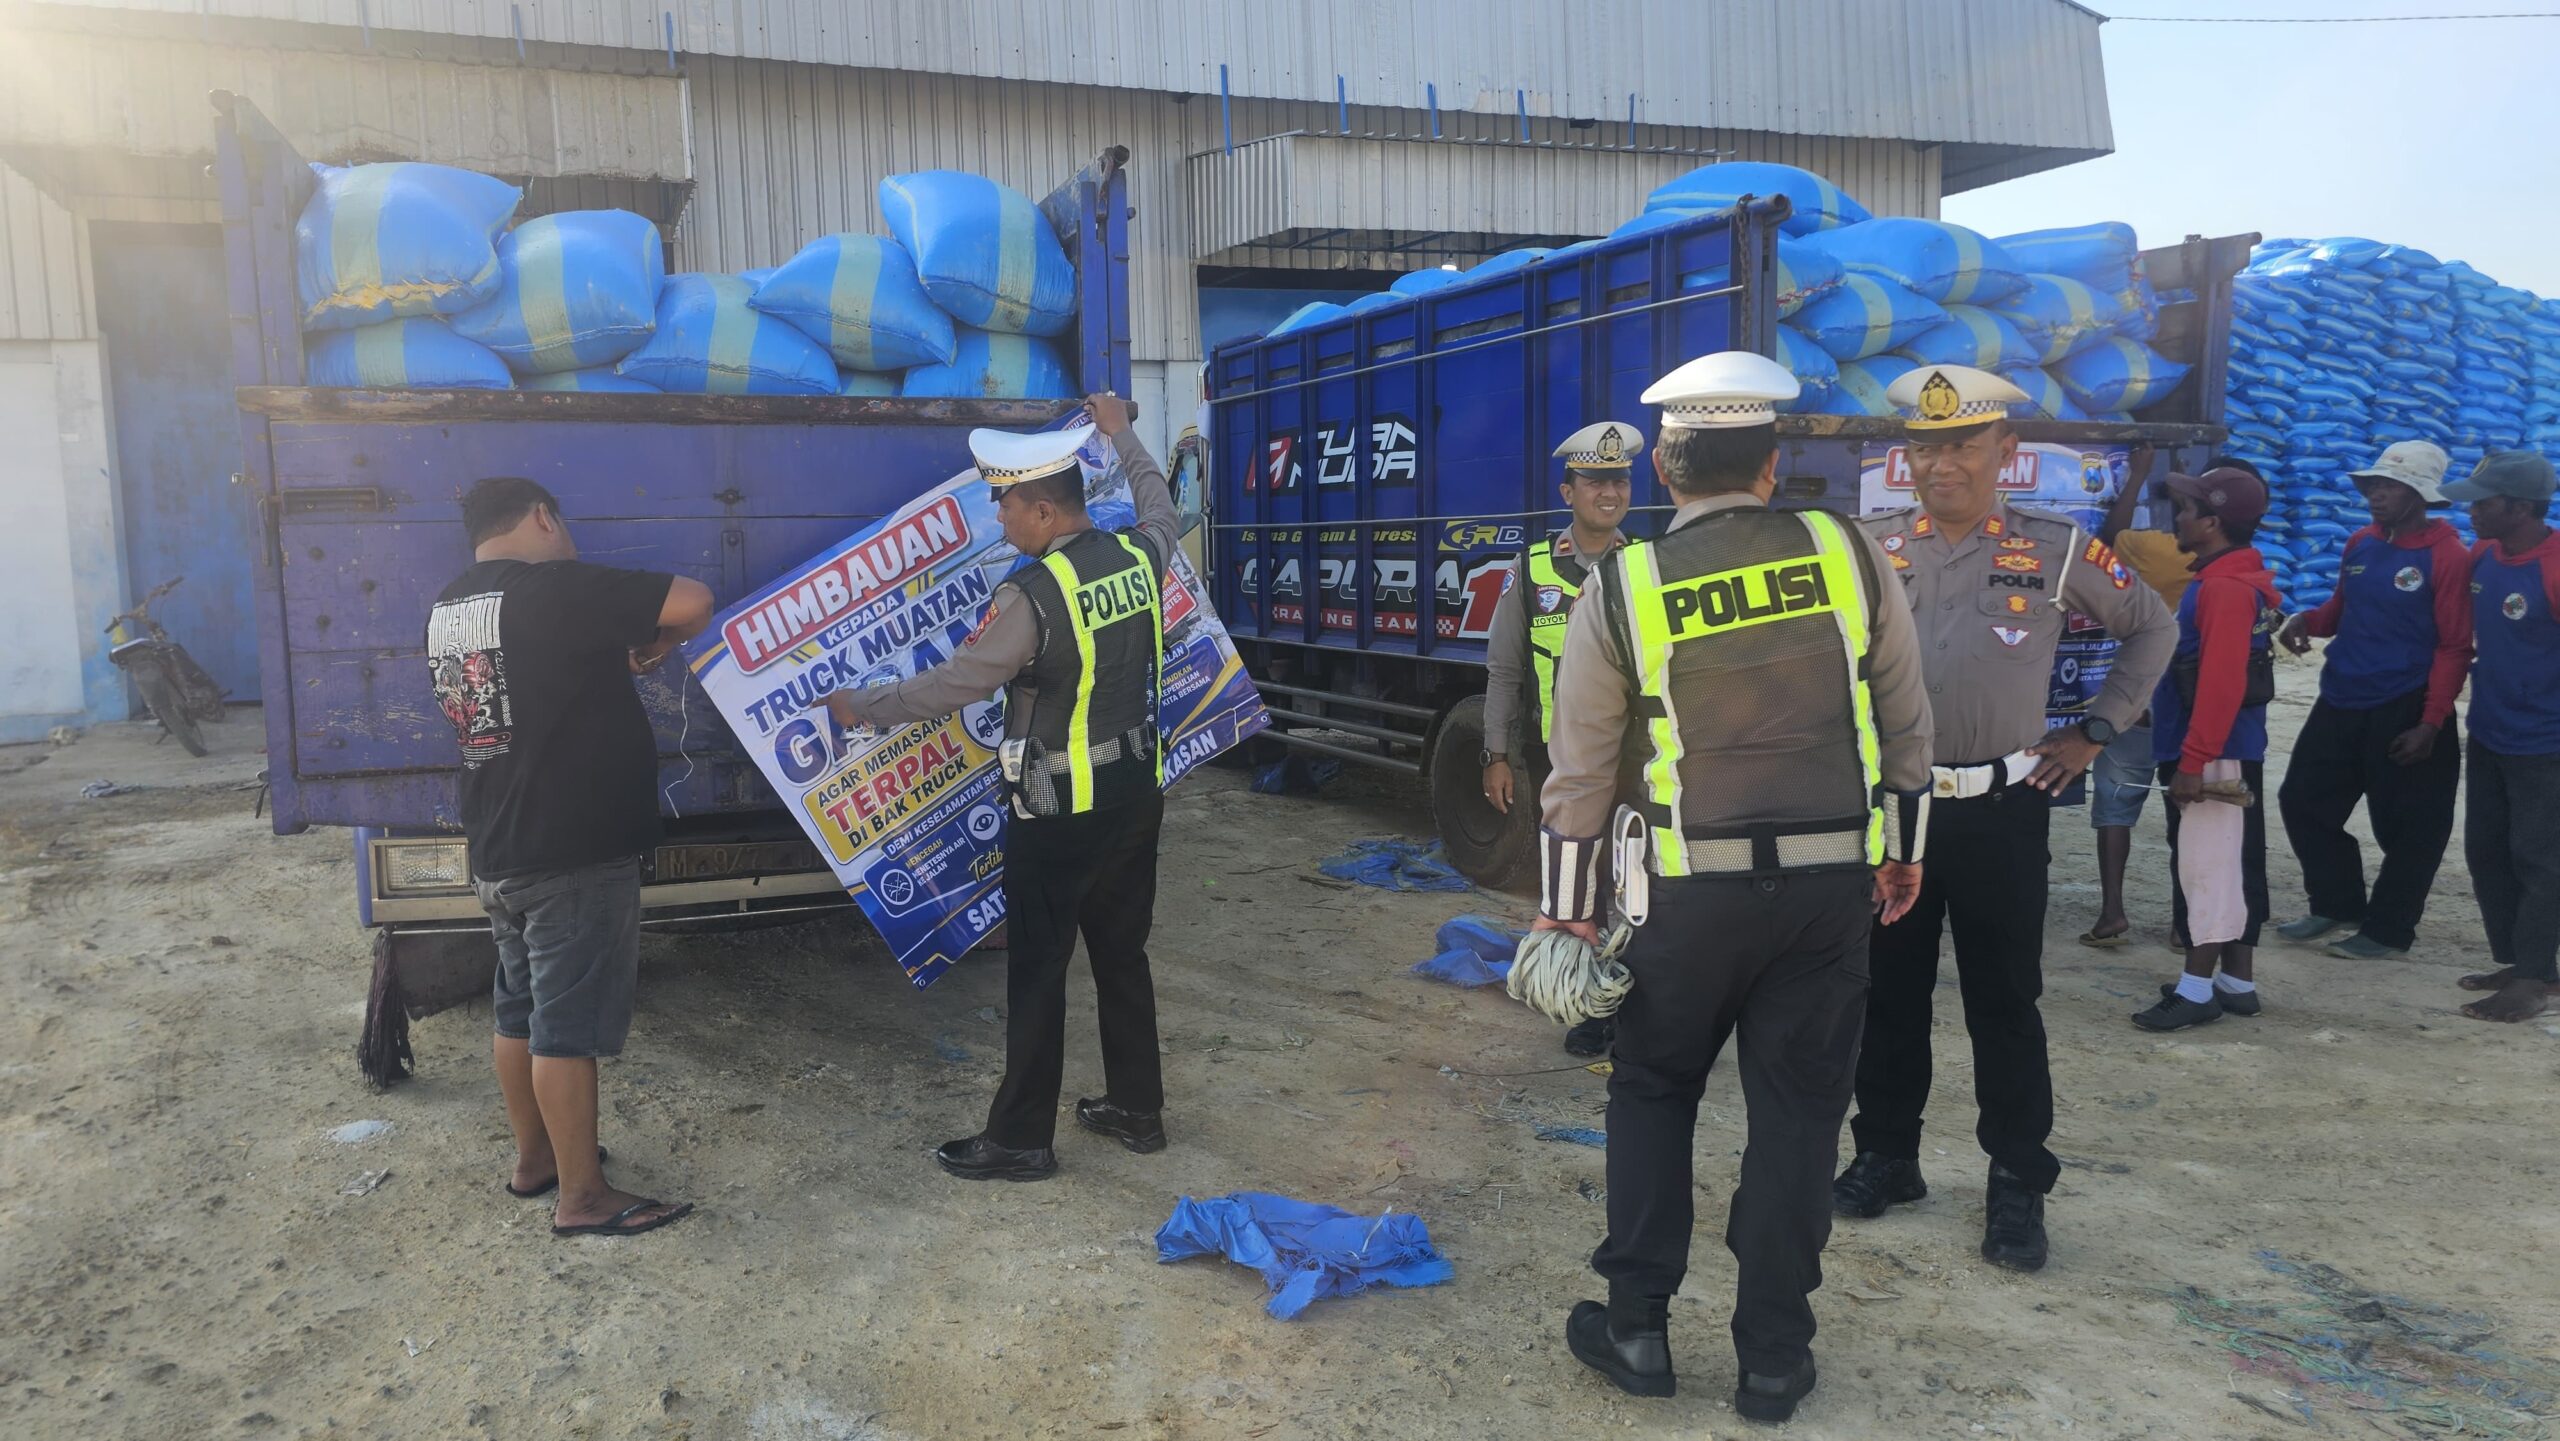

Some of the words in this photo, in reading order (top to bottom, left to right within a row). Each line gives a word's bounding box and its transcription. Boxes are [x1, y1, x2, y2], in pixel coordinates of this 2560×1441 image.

[736, 504, 958, 662] HIMBAUAN
[1076, 567, 1154, 628] POLISI
[1661, 562, 1832, 635] POLISI
[1989, 574, 2045, 590] POLRI
[826, 595, 899, 645] KEPADA
[1279, 608, 1353, 626] RAING
[1374, 616, 1417, 630] EAM
[1534, 615, 1565, 625] YOYOK
[745, 646, 859, 733] TRUCK
[858, 566, 991, 665] MUATAN
[1162, 645, 1184, 666] ALAN
[1161, 694, 1178, 707] KITA
[1178, 675, 1211, 698] BERSAMA
[818, 767, 862, 808] AGAR
[864, 712, 953, 775] MEMASANG
[826, 729, 964, 833] TERPAL
[1162, 729, 1218, 788] KASAN
[848, 827, 867, 849] DI
[871, 799, 909, 831] BAK
[910, 755, 969, 803] TRUCK
[887, 831, 914, 855] DEMI
[915, 780, 984, 839] KESELAMATAN
[905, 838, 944, 870] MENCEGAH
[911, 845, 955, 880] MENETESNYA
[953, 837, 966, 850] AIR
[926, 861, 948, 881] JALAN
